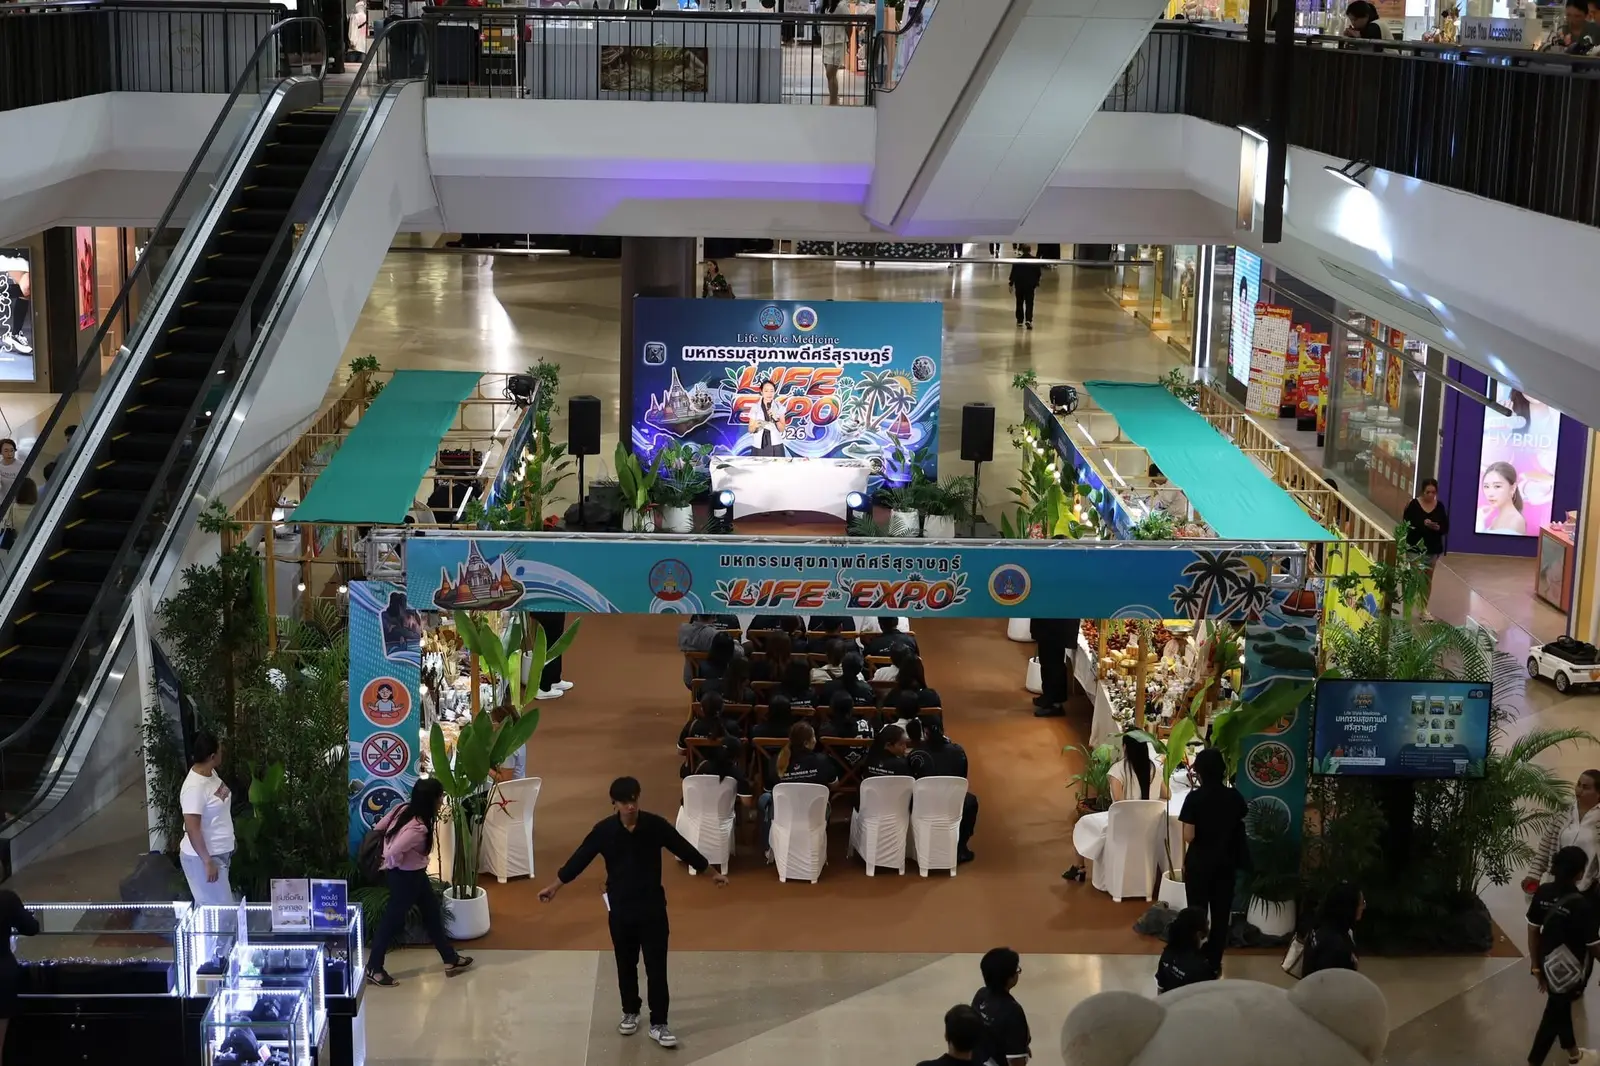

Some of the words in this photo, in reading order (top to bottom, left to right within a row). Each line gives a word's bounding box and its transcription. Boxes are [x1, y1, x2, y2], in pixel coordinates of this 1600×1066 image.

[1465, 21, 1476, 39] Love
[1478, 22, 1488, 40] You
[1488, 23, 1523, 42] Accessories
[737, 333, 758, 344] Life
[761, 333, 788, 346] Style
[792, 334, 840, 345] Medicine
[683, 347, 891, 365] มหกรรมสุขภาพดีศรีสุราษฎร์
[1488, 431, 1552, 449] HYBRID
[728, 579, 832, 609] LIFE
[847, 579, 957, 609] EXPO
